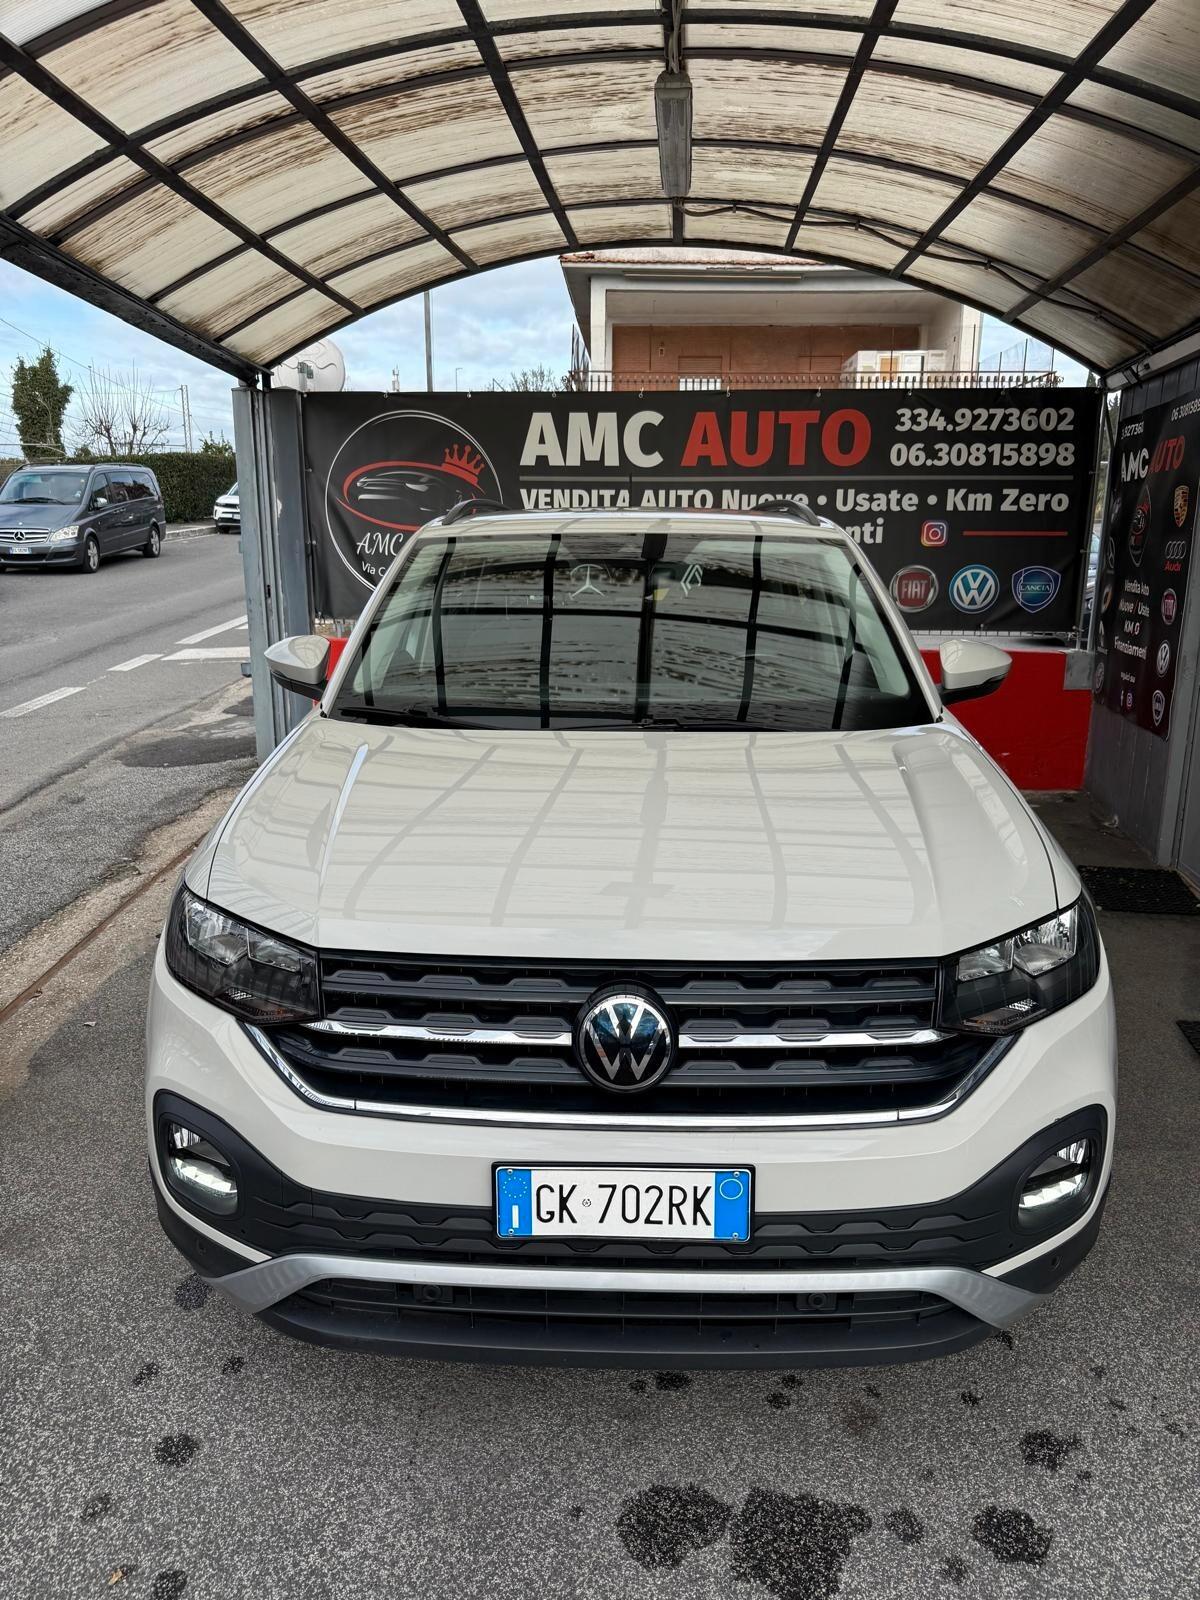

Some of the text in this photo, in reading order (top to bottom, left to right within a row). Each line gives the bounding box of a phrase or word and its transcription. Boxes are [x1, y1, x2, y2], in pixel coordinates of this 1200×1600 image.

[895, 407, 1075, 432] 334.9273602
[520, 408, 872, 468] AMC AUTO
[890, 443, 1075, 467] 06.30815898
[1121, 448, 1149, 481] AMC
[519, 488, 630, 509] VENDITA
[640, 488, 713, 509] AUTO
[836, 488, 919, 512] Usate
[946, 488, 998, 512] Km
[1000, 488, 1070, 512] Zero
[356, 532, 404, 556] AMC
[361, 561, 376, 575] Via
[902, 580, 928, 599] FIAT
[1020, 584, 1051, 592] LANCIA
[536, 1184, 712, 1226] GK 702RK
